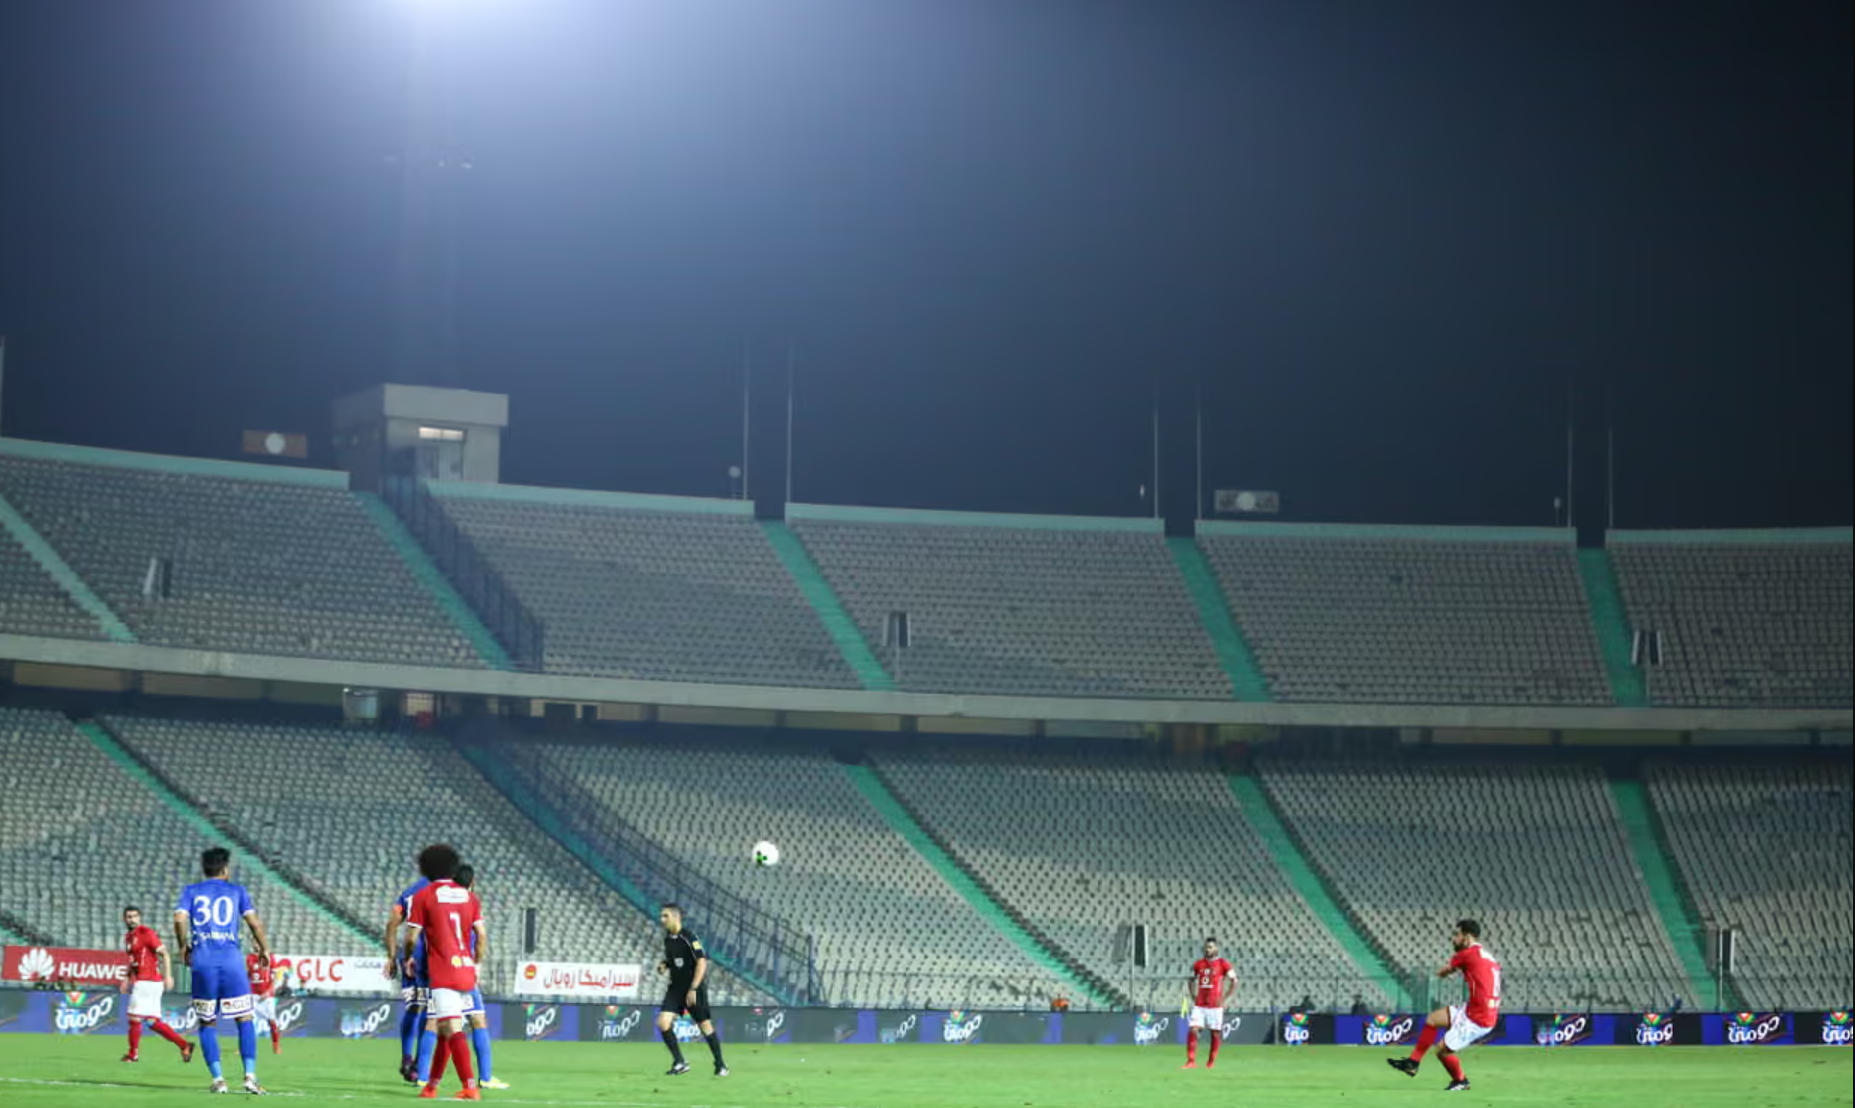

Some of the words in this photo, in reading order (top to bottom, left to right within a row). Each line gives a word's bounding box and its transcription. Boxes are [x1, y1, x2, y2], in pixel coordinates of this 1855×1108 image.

[193, 895, 234, 926] 30
[58, 961, 128, 980] HUAWE
[296, 958, 344, 982] GLC
